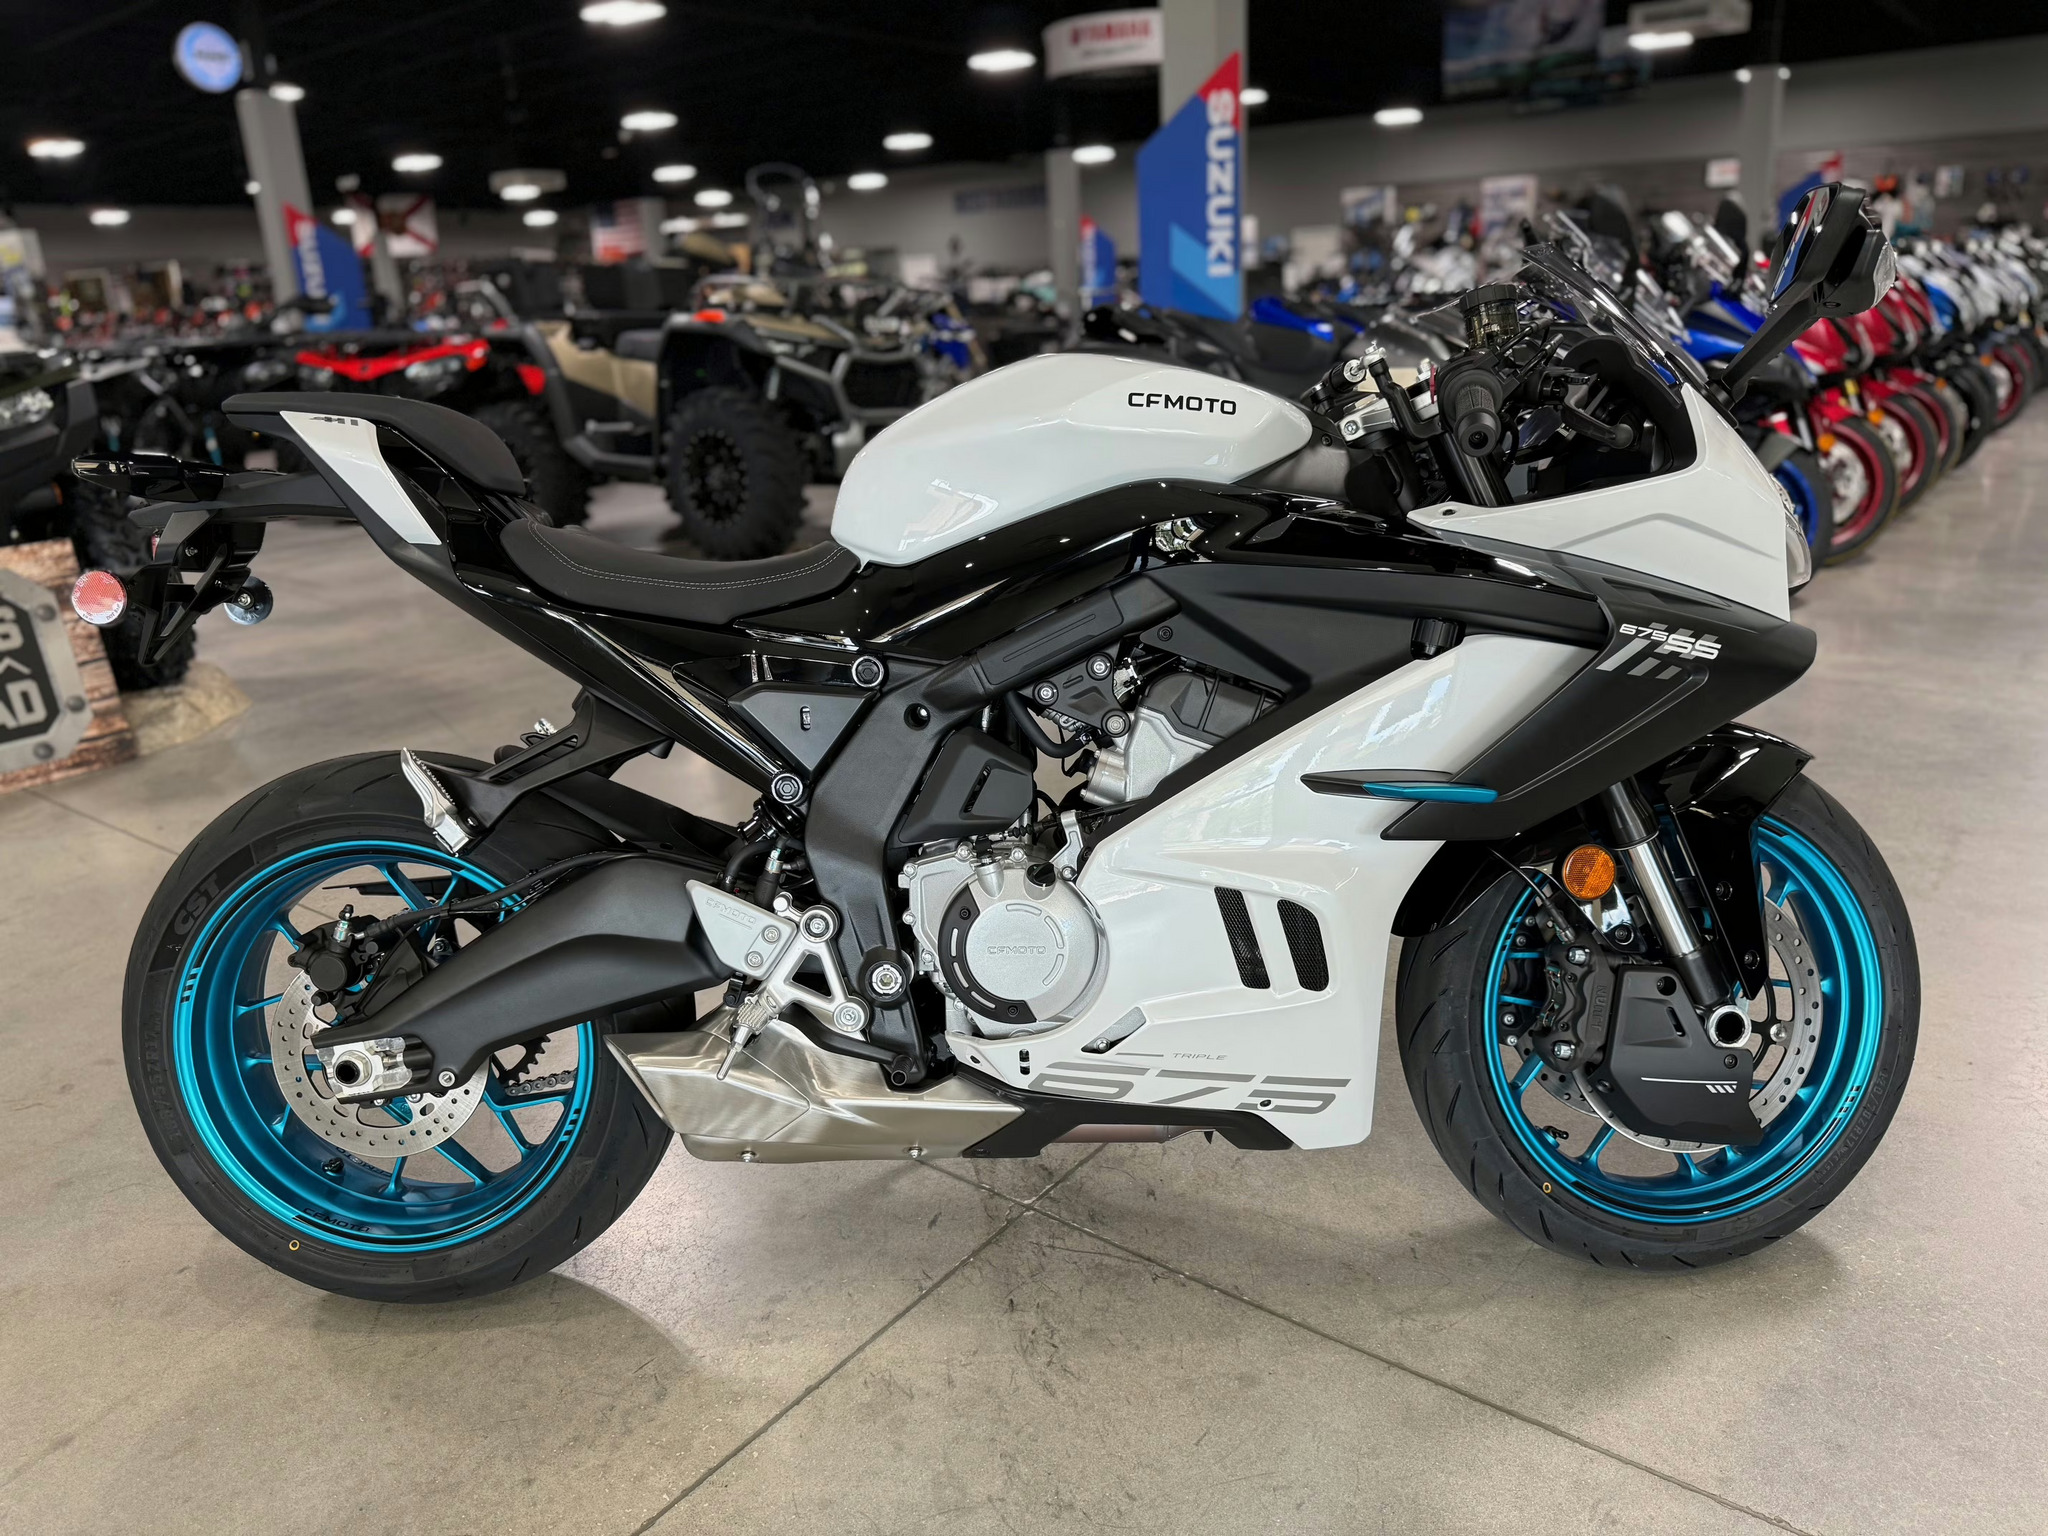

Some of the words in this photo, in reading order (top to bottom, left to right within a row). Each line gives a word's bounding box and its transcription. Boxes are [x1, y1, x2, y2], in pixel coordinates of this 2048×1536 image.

[1205, 88, 1236, 280] SUZUKI
[1127, 392, 1237, 415] CFMOTO
[174, 872, 221, 936] CST
[705, 897, 757, 924] CFMOTO
[986, 945, 1047, 956] CFMOTO
[1171, 1052, 1228, 1061] TRIPLE
[1027, 1061, 1352, 1115] 675
[302, 1207, 371, 1232] CFMOTO
